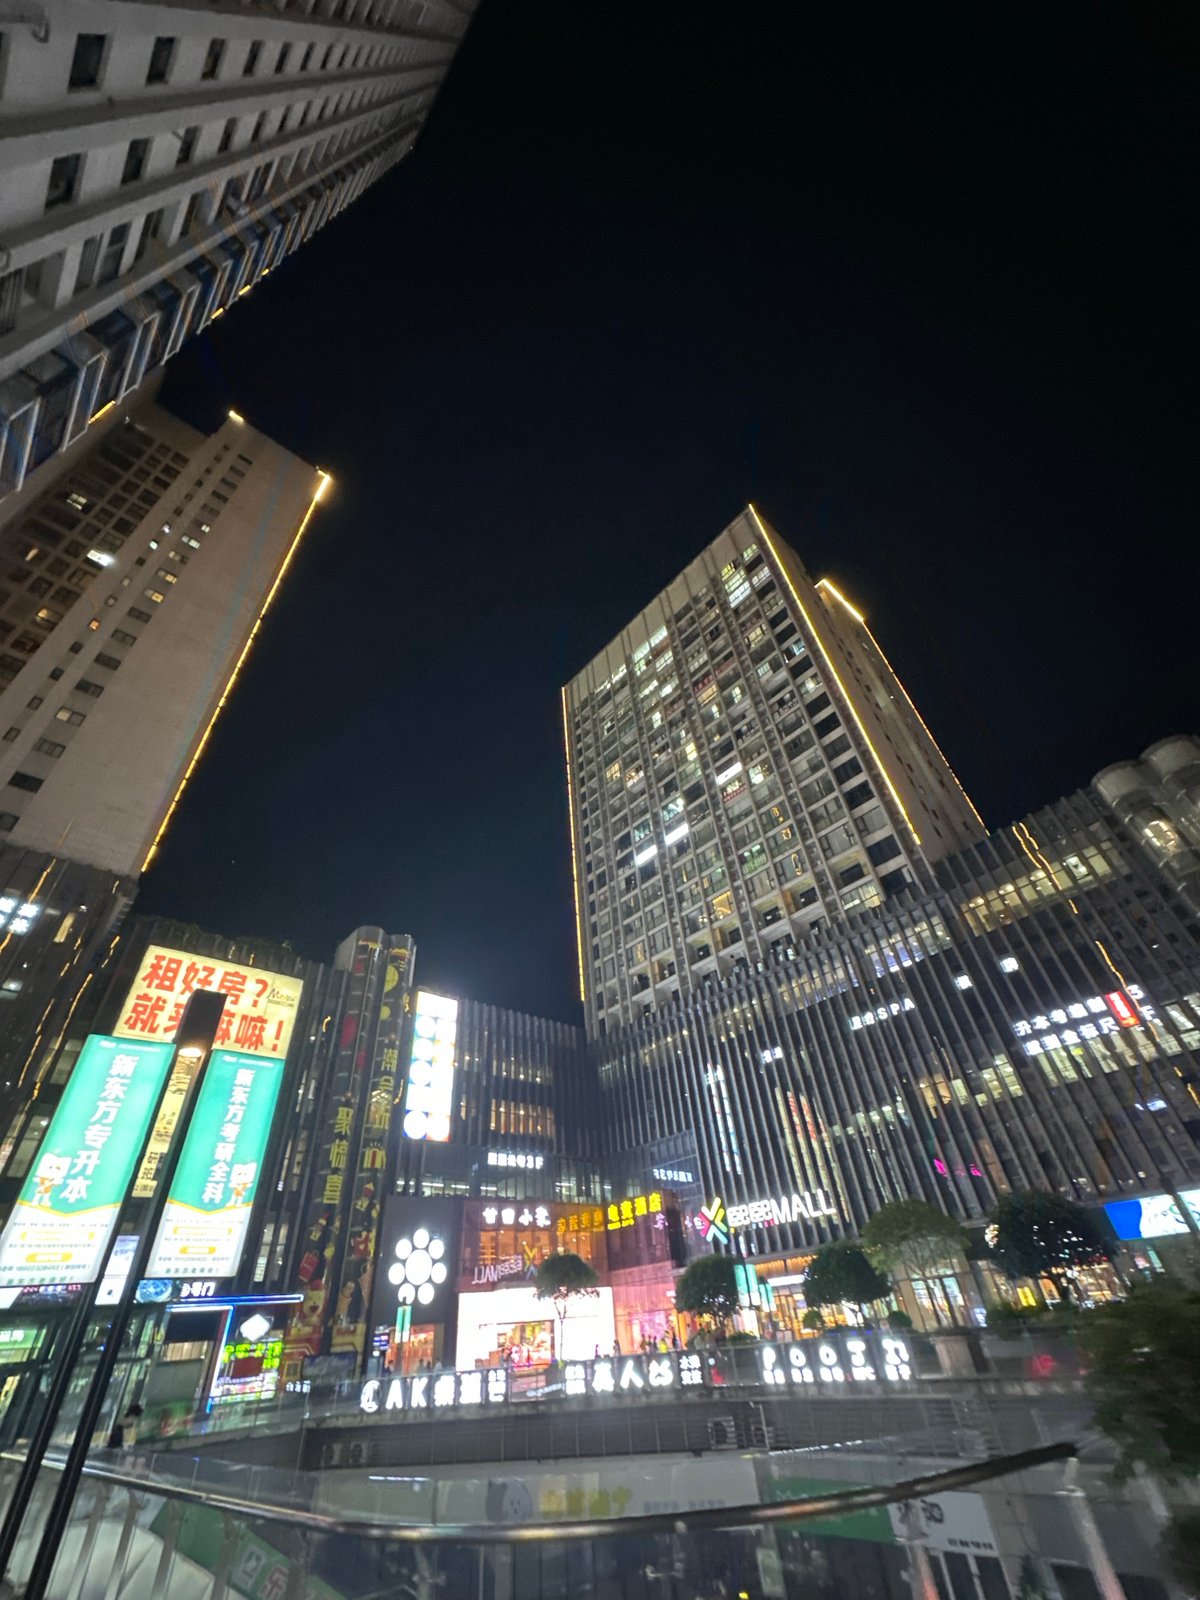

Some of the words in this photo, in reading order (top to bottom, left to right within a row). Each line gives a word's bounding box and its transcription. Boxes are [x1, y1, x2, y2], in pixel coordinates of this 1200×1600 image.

[60, 1053, 140, 1203] 新东方专升本
[202, 1068, 256, 1204] 新东方考研全科
